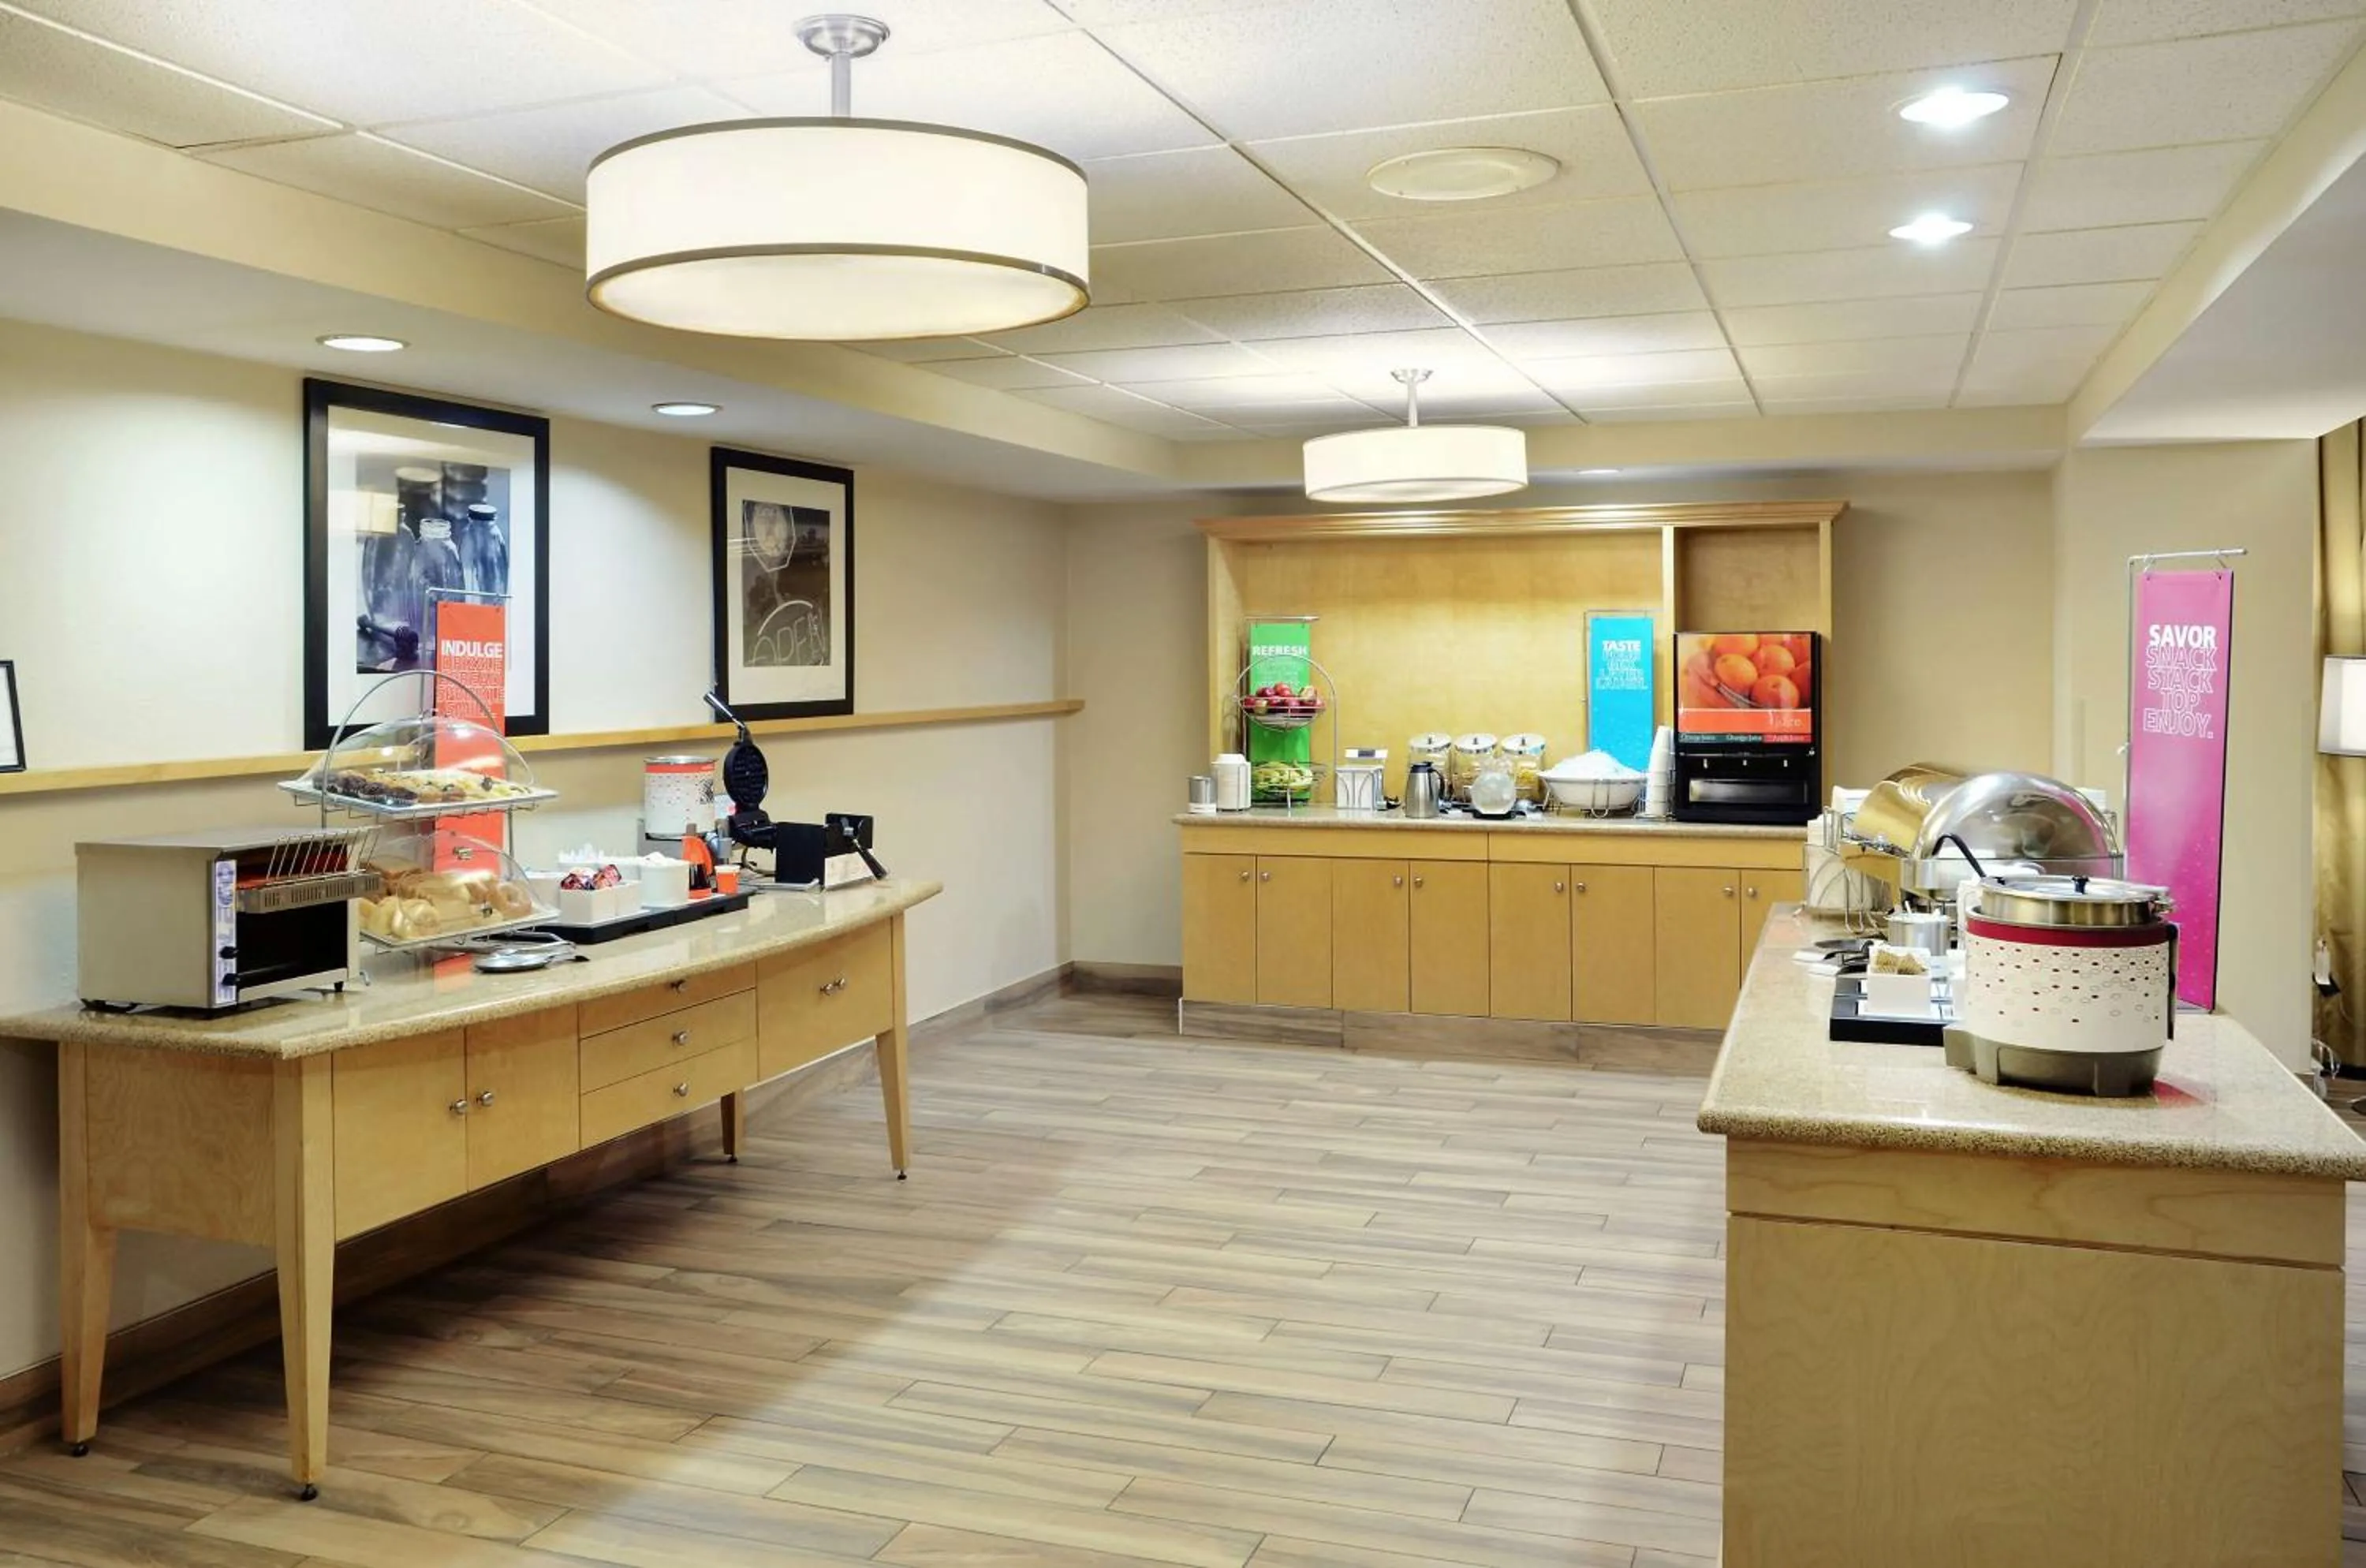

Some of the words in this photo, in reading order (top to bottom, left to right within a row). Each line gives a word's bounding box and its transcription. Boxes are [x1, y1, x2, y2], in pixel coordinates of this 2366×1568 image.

[1602, 640, 1641, 651] TASTE
[2148, 624, 2217, 648] SAVOR
[441, 640, 503, 658] INDULGE
[1252, 644, 1308, 656] REFRESH
[2145, 644, 2218, 671] SNACK
[442, 656, 503, 672] DRIZZLE
[2148, 667, 2214, 693] STACK
[2160, 689, 2200, 714] TOP
[2143, 708, 2214, 739] ENJOY.
